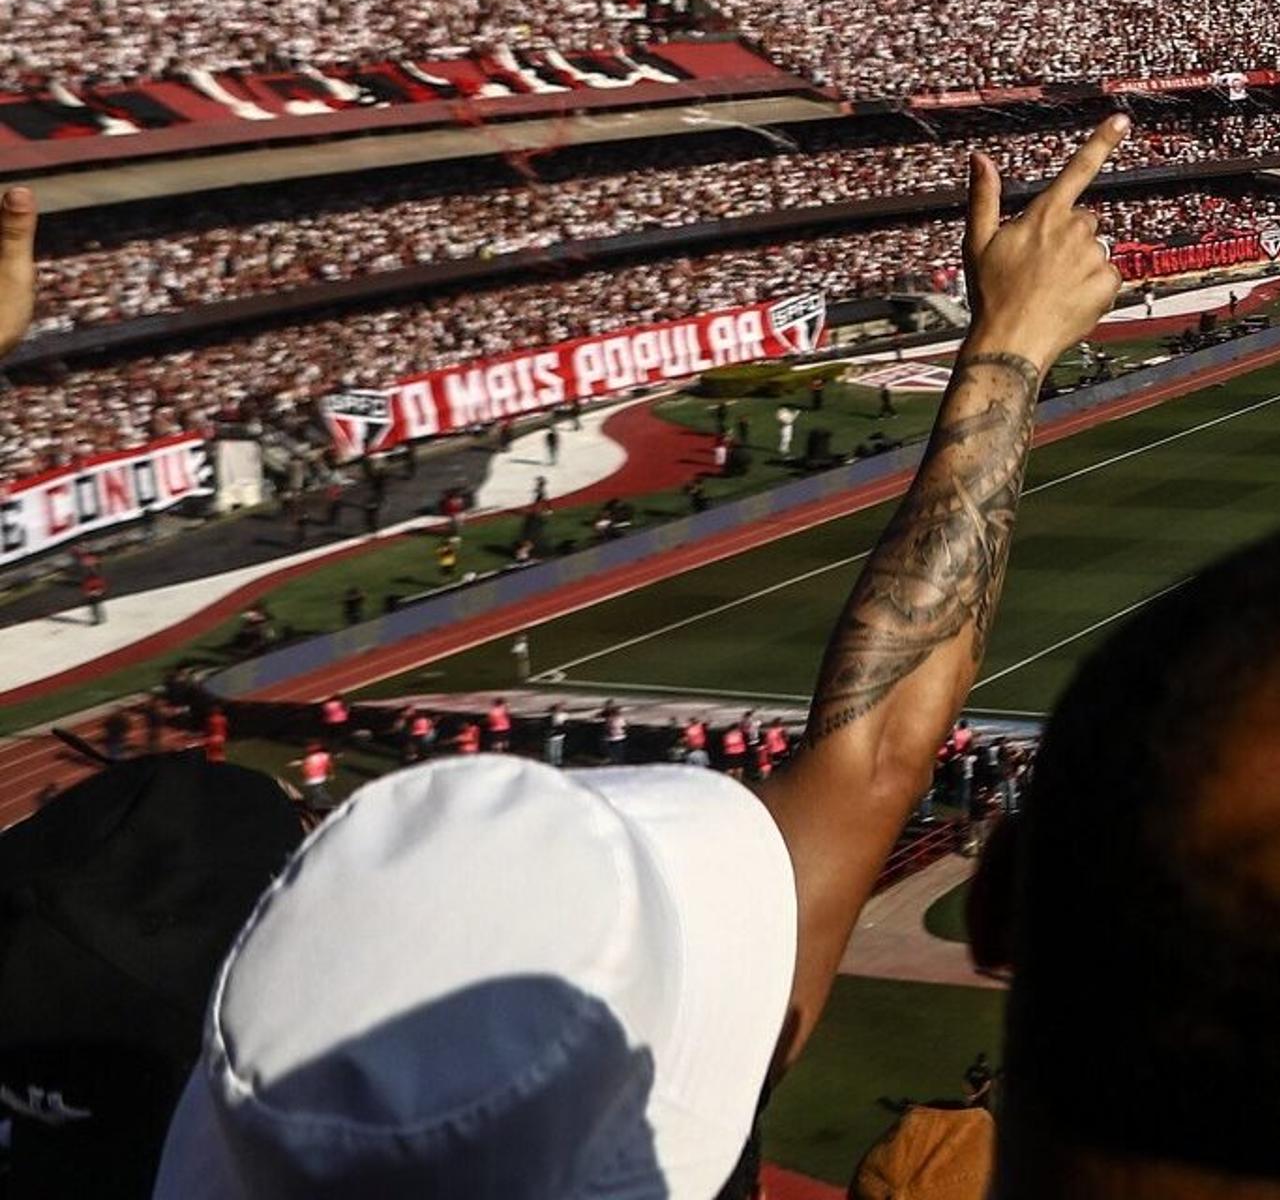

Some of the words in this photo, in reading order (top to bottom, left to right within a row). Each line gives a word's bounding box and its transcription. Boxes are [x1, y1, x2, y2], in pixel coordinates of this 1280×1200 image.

[401, 380, 442, 438] O
[443, 350, 567, 429] MAIS
[574, 308, 768, 398] POPULAR
